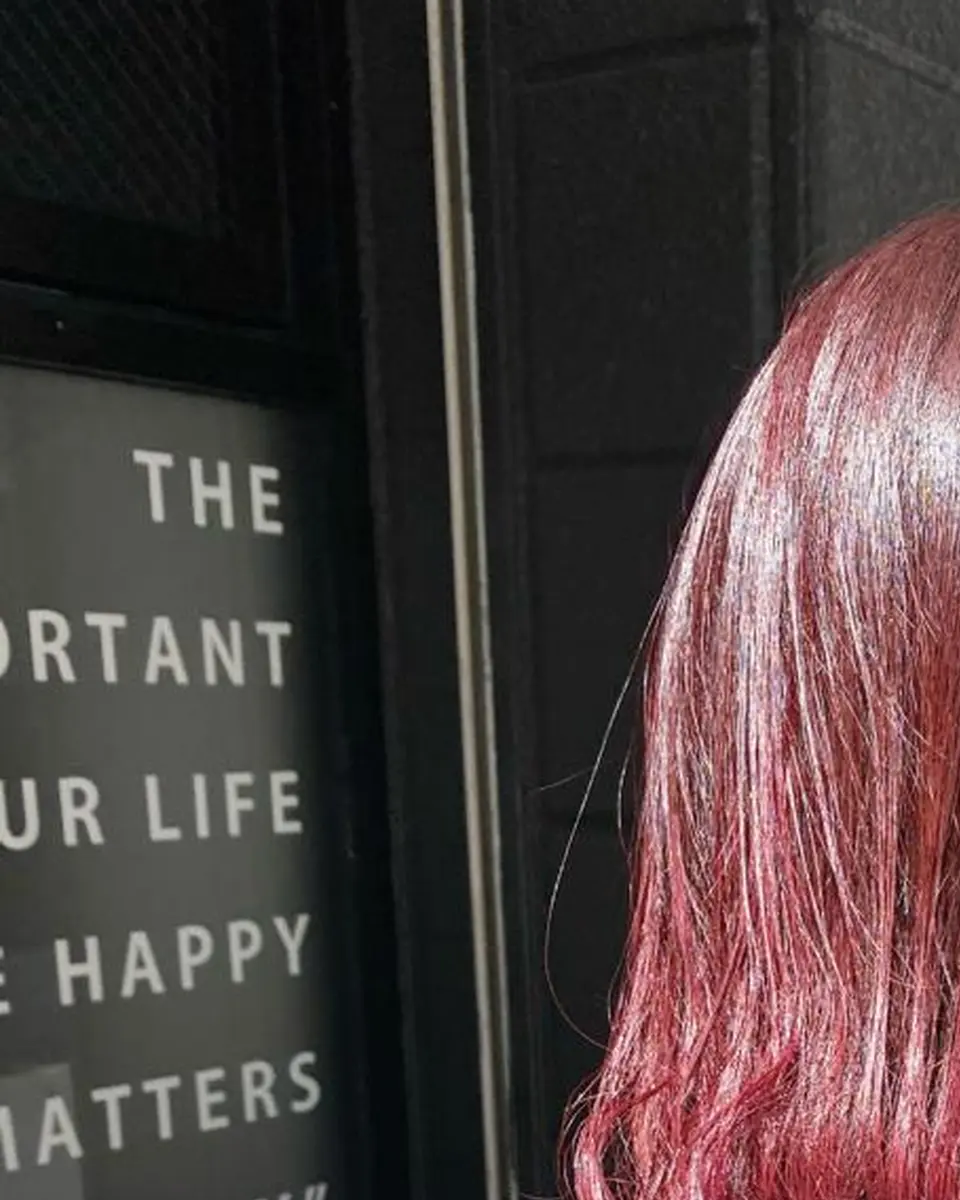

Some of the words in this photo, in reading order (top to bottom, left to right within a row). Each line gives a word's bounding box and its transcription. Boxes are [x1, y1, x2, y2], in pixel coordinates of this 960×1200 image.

[133, 448, 284, 535] THE
[0, 609, 292, 687] RTANT
[0, 772, 104, 850] UR
[144, 770, 303, 842] LIFE
[54, 912, 311, 1007] HAPPY
